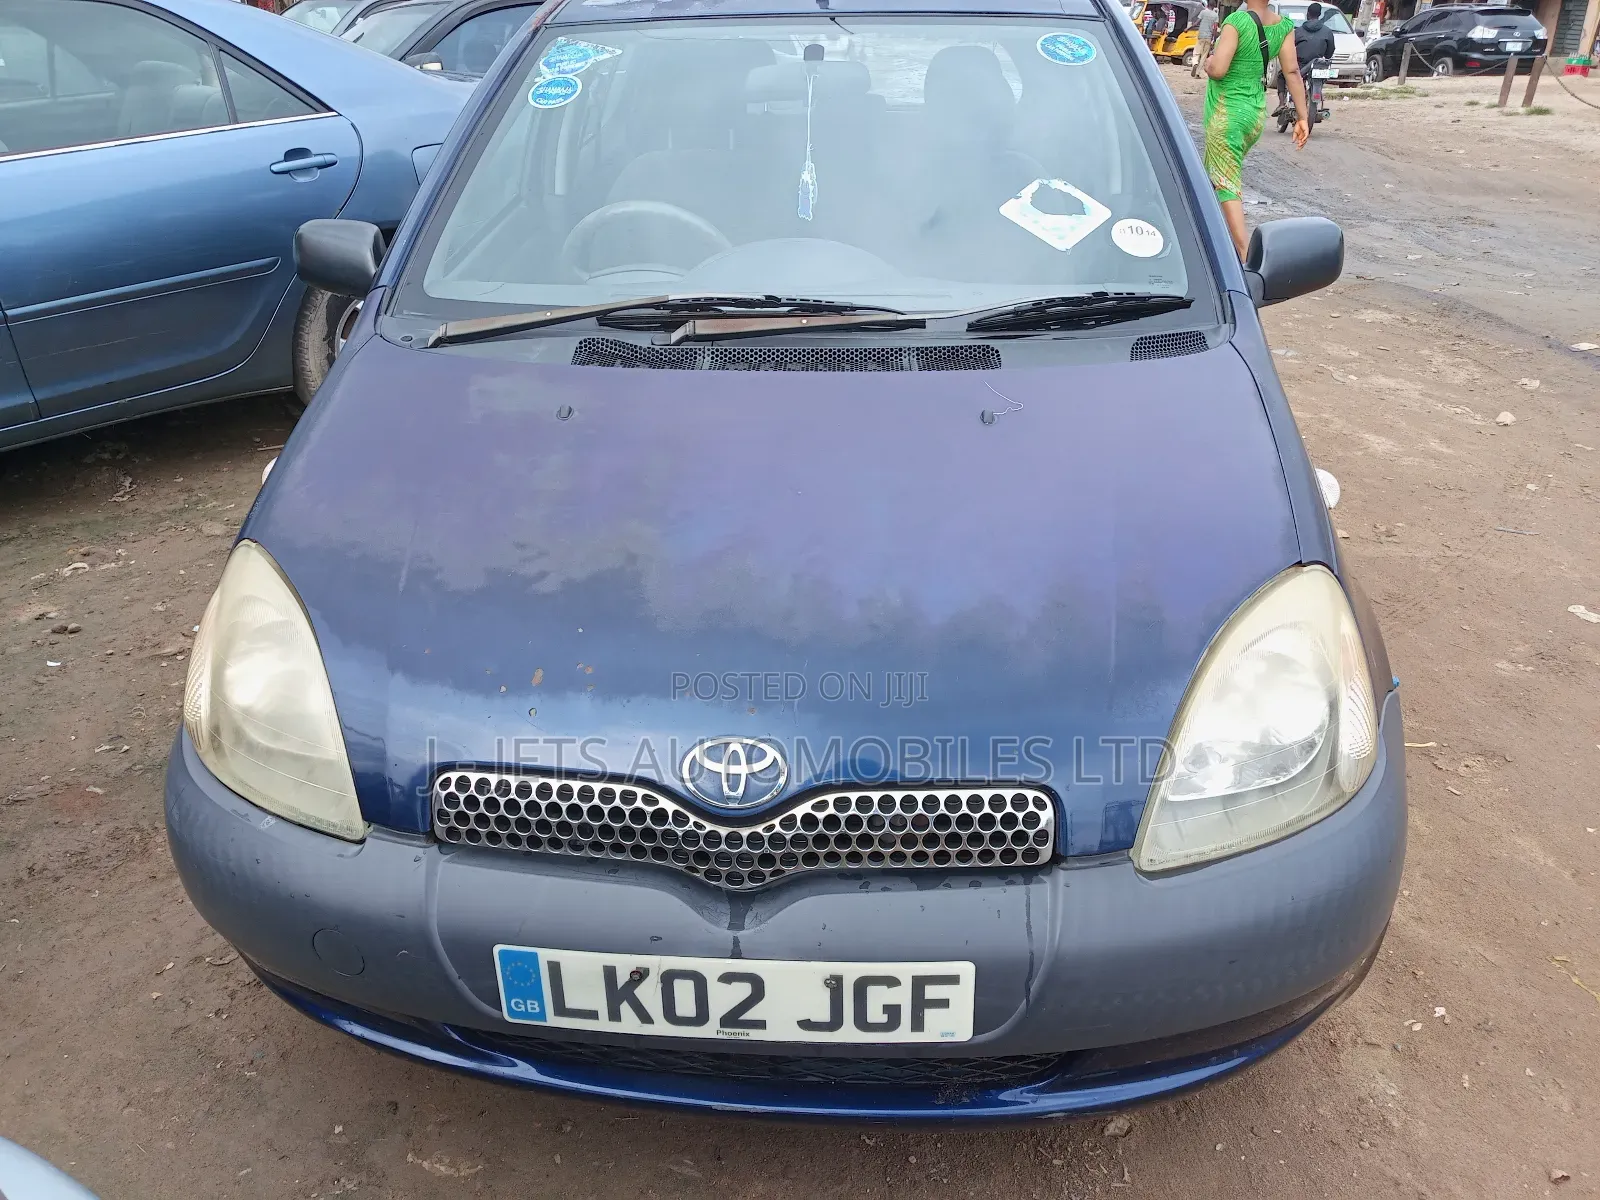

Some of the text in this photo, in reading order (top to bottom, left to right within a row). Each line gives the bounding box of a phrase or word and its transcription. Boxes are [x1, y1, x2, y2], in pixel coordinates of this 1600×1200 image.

[1127, 225, 1144, 236] 10
[546, 960, 961, 1033] LK02 JGF
[511, 998, 540, 1013] GB
[716, 1029, 750, 1037] Phoenix
